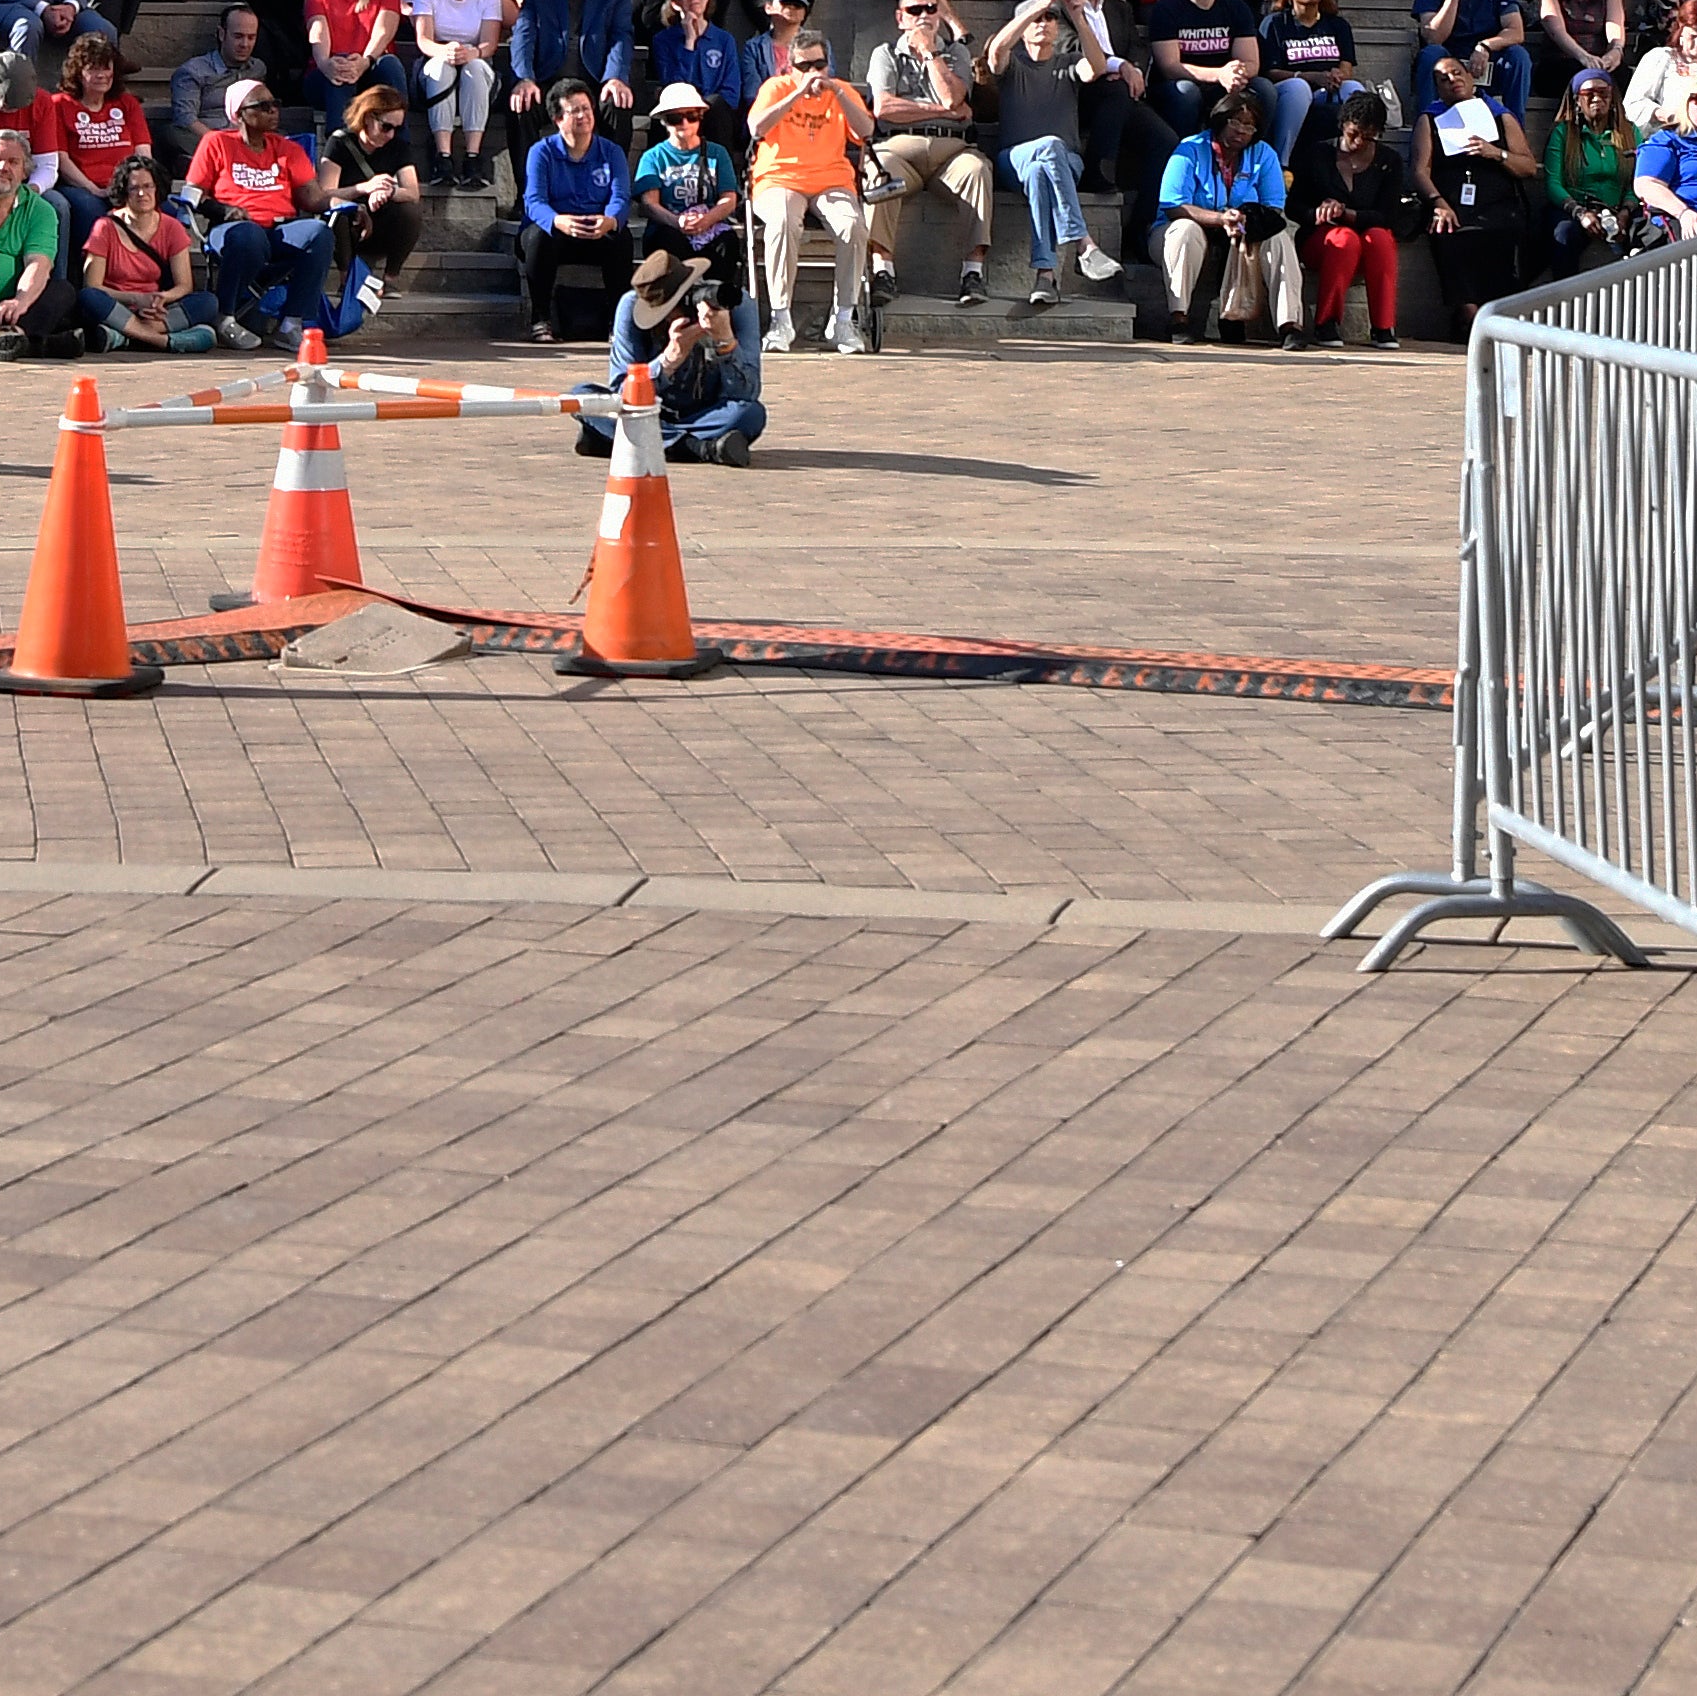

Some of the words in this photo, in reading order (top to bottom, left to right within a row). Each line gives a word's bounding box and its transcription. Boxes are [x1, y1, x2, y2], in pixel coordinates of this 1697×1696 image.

[1179, 27, 1230, 39] WHITNEY
[1179, 39, 1230, 52] STRONG
[1285, 36, 1336, 47] WHITNEY
[1286, 46, 1340, 60] STRONG
[79, 134, 120, 143] ACTION
